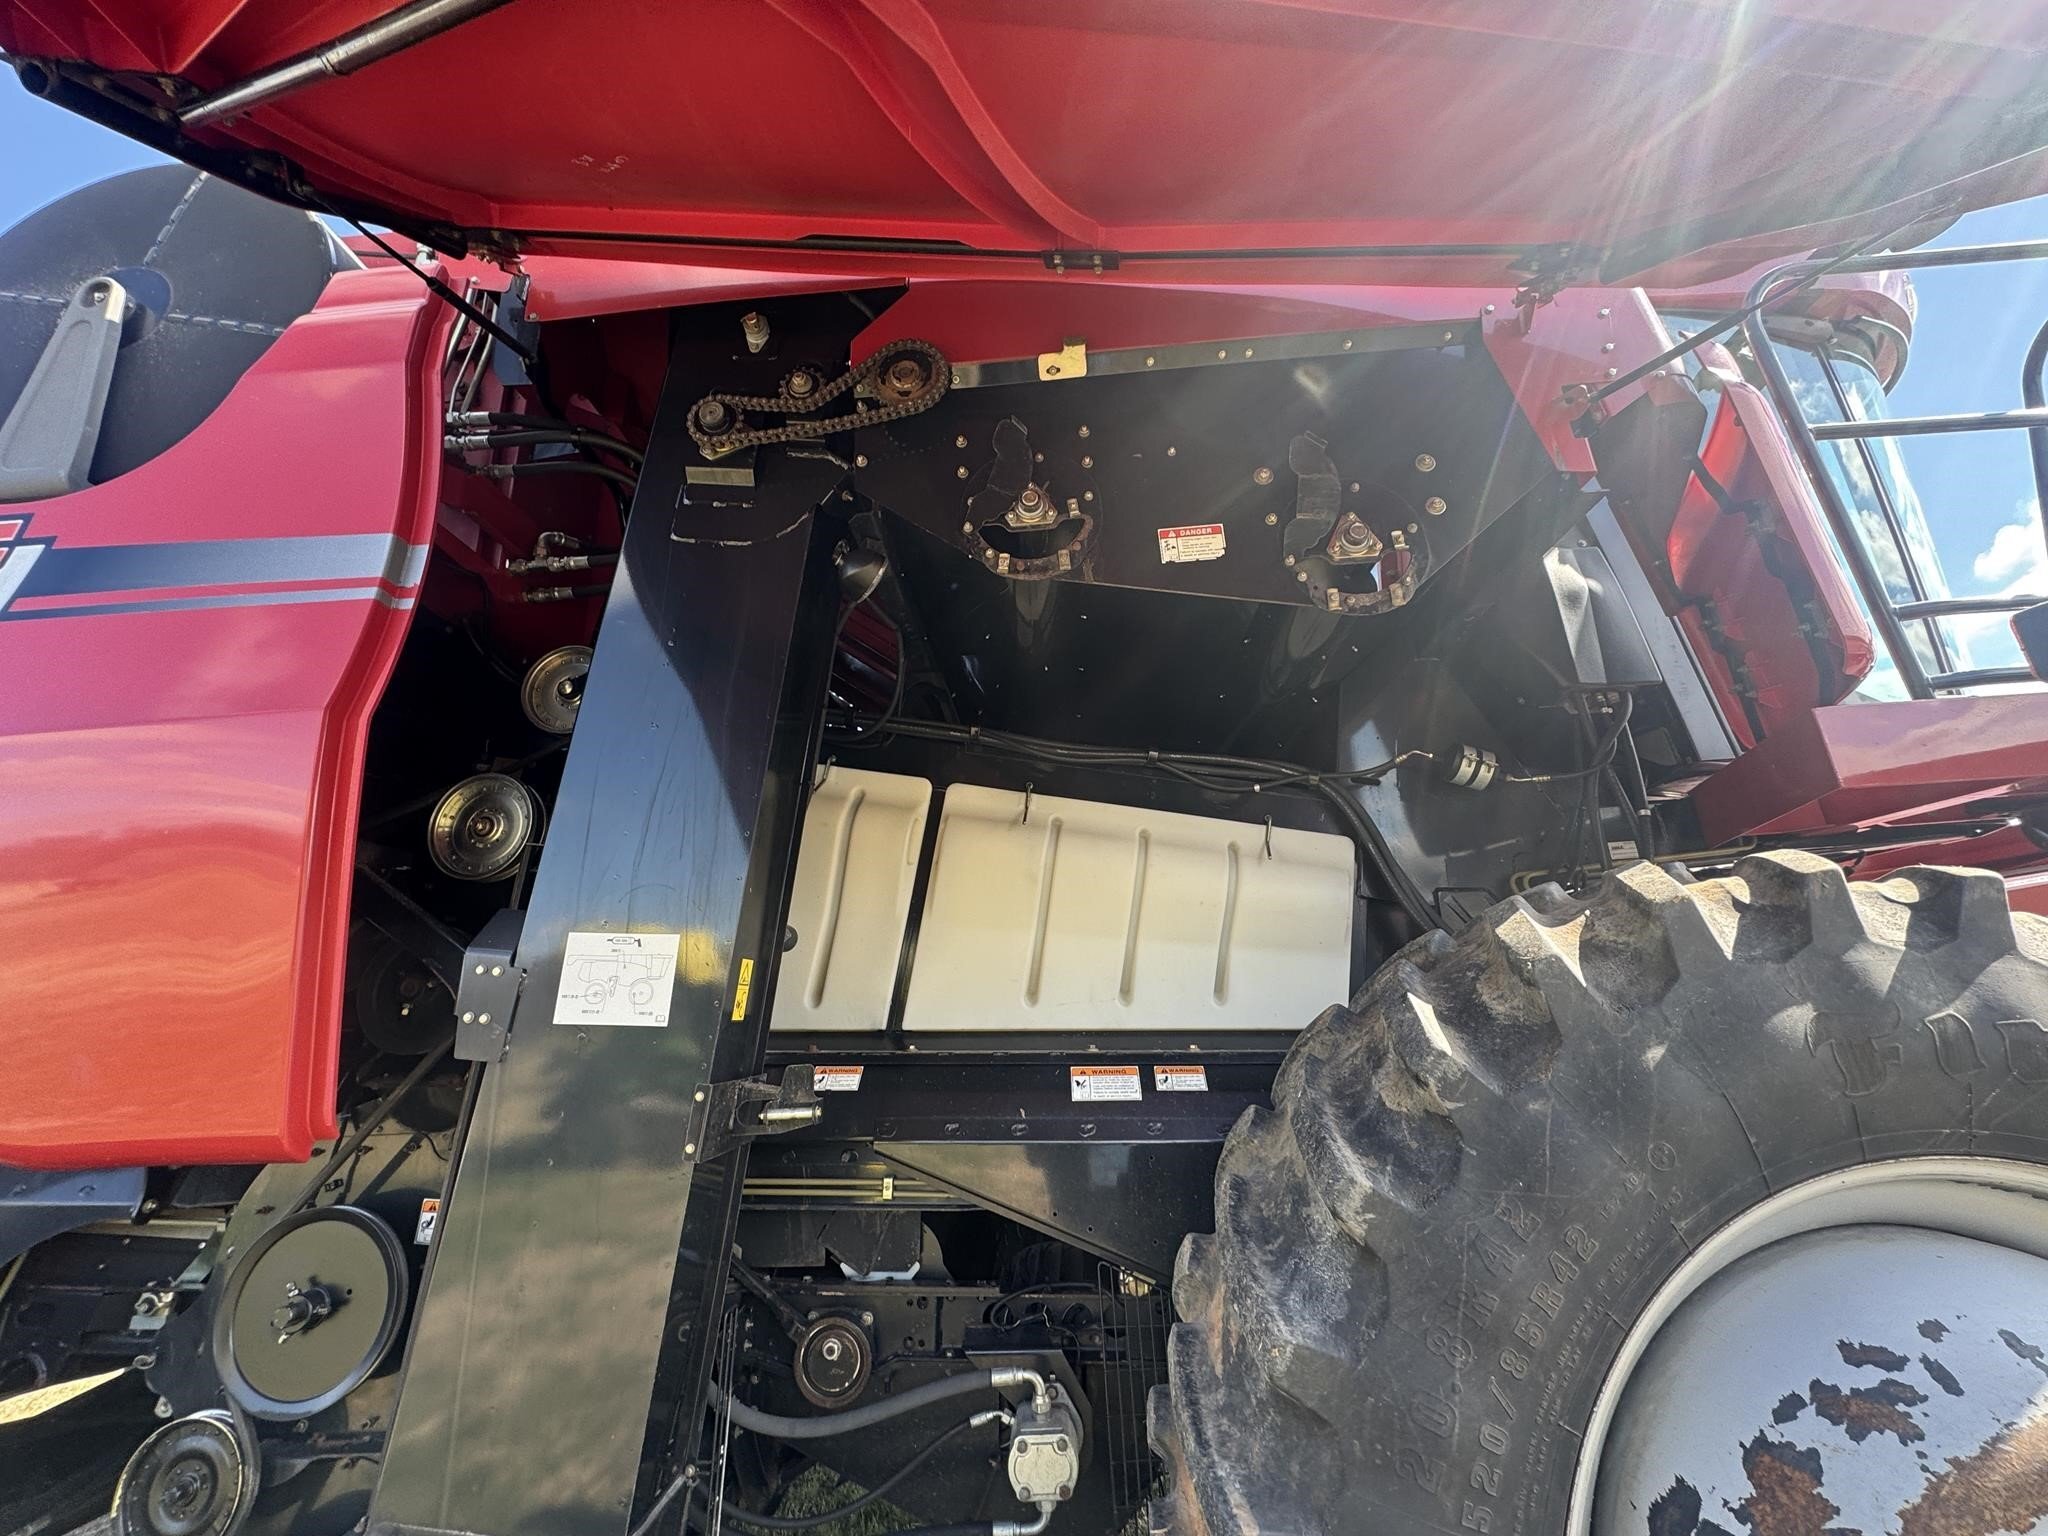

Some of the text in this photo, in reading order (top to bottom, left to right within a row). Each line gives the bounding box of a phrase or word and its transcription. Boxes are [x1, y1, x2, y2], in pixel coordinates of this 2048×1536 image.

[1179, 527, 1213, 537] DANGER
[1396, 1197, 1543, 1495] 20.8R42
[1460, 1223, 1600, 1535] 520/85R42
